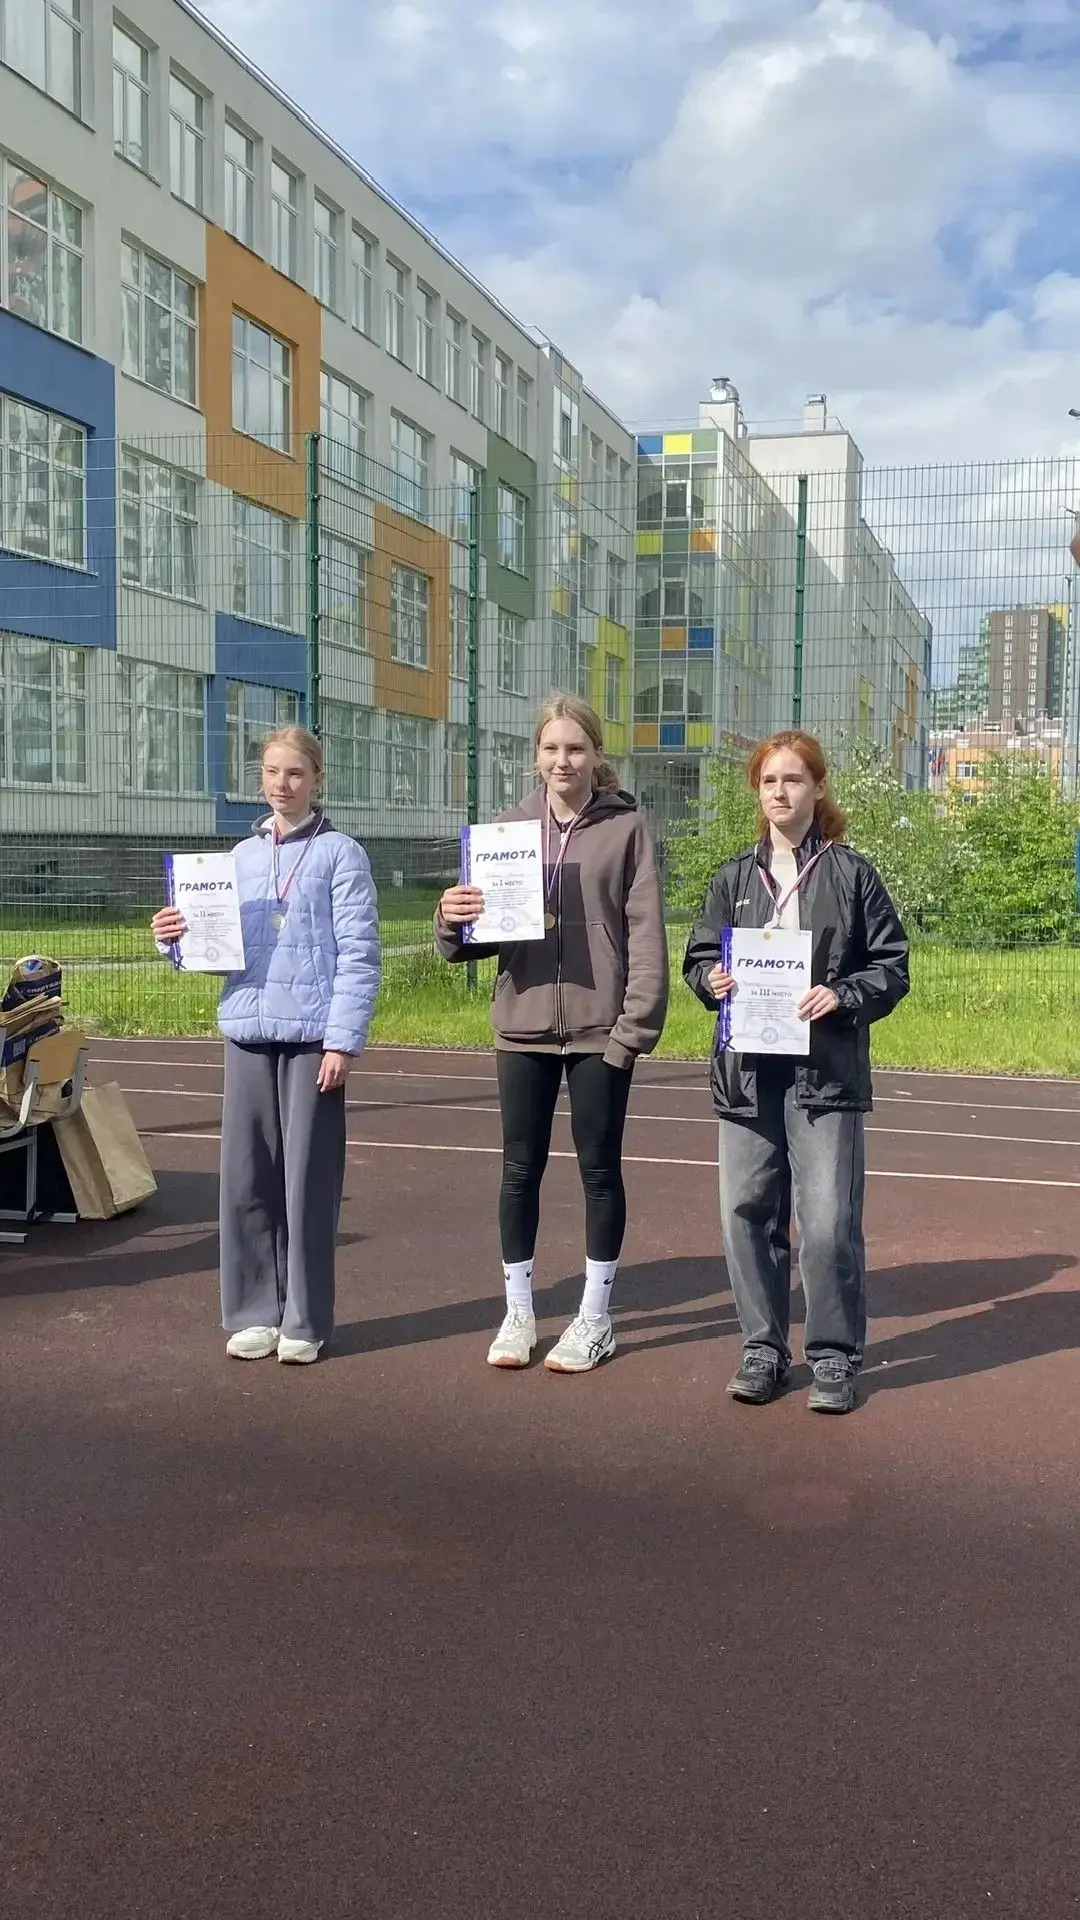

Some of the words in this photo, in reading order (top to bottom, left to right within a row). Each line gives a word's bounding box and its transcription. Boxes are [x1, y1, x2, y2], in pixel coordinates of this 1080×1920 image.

[475, 849, 537, 862] ГРАМОТА
[179, 882, 233, 892] ГРАМОТА
[736, 958, 805, 970] ГРАМОТА
